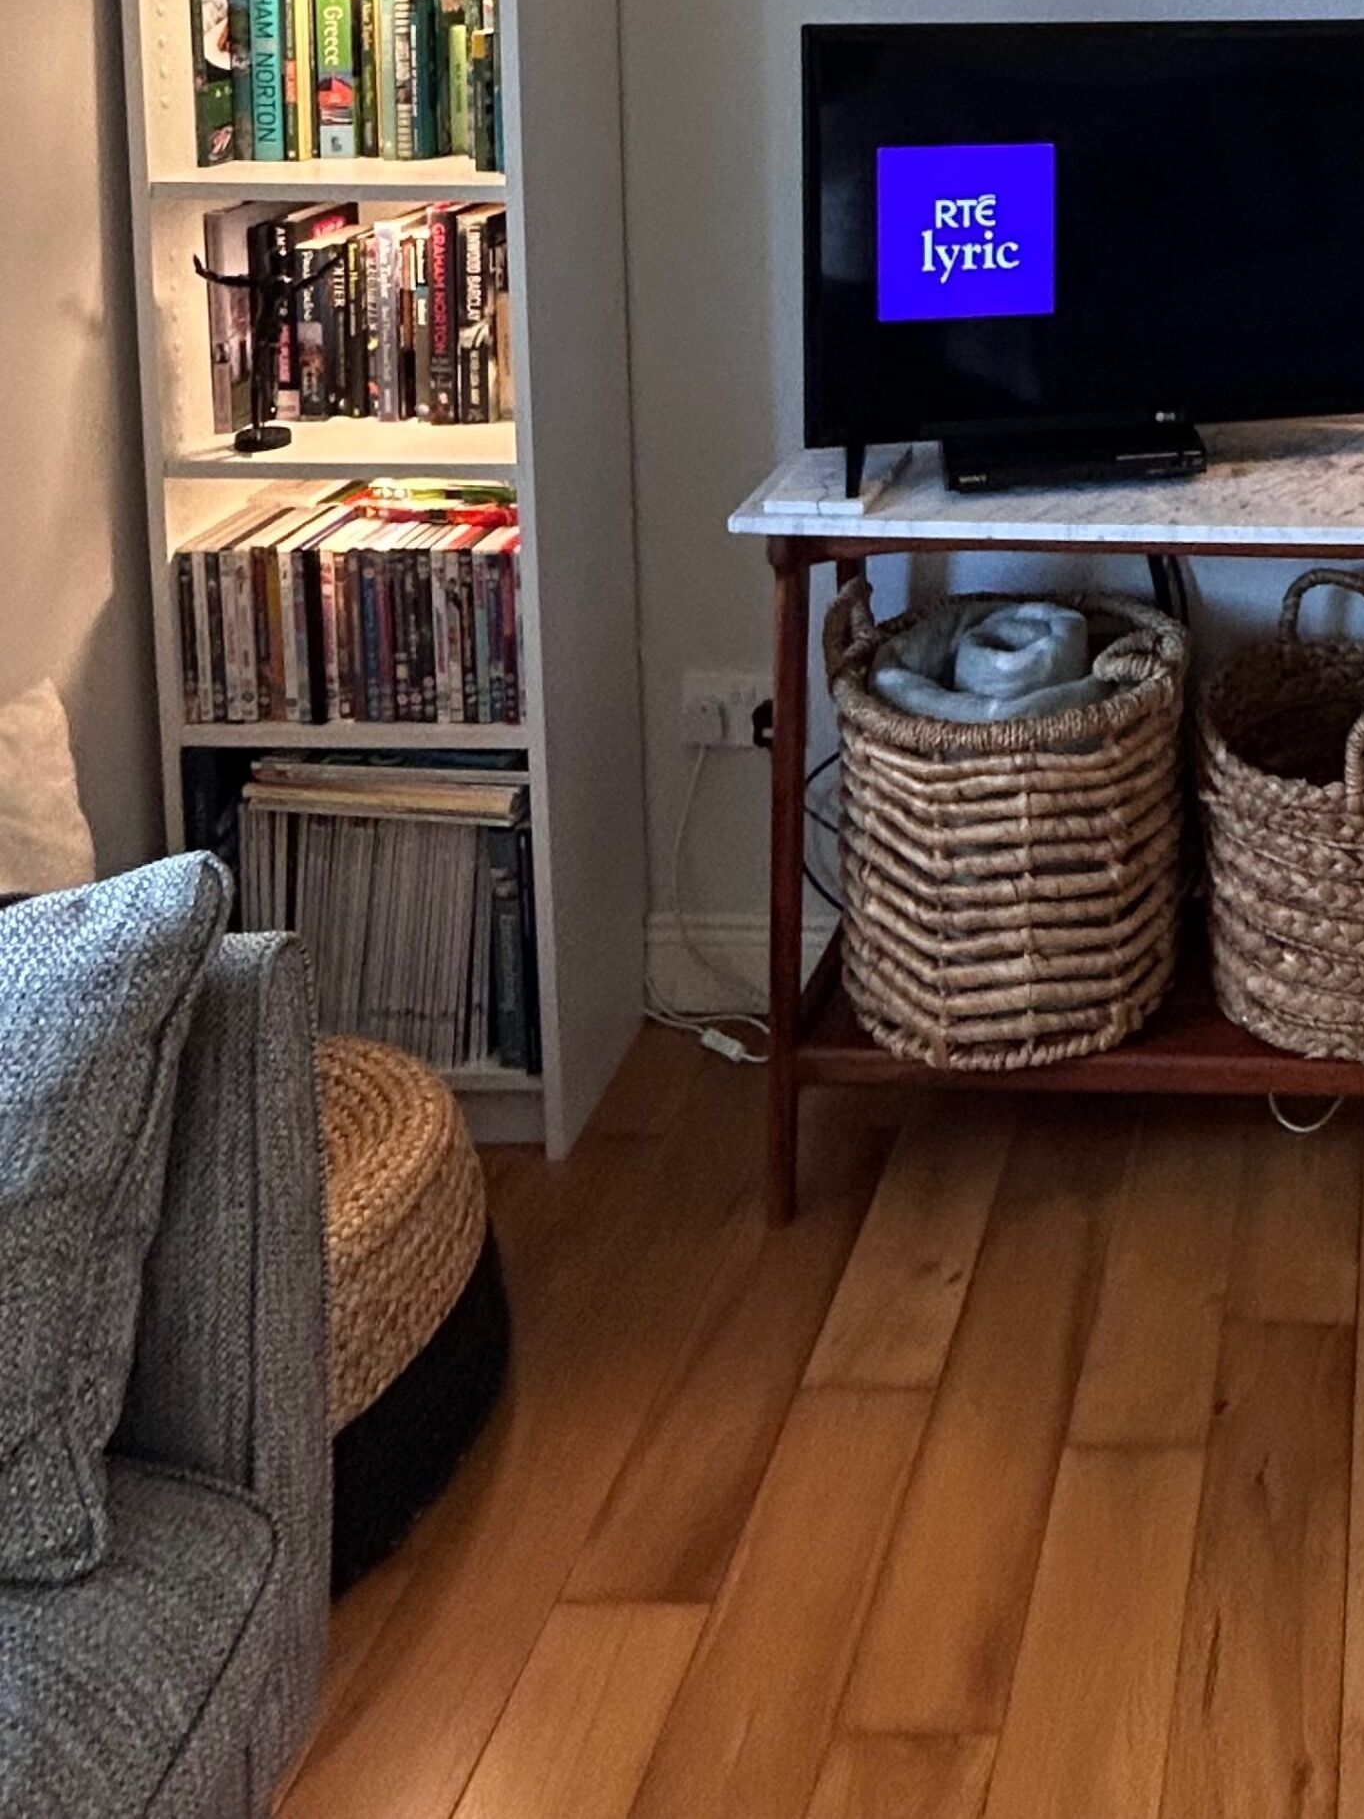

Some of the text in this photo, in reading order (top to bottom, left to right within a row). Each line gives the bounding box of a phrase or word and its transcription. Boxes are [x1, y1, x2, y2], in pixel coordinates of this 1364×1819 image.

[323, 6, 344, 66] Greece
[255, 52, 277, 142] NORTON
[935, 194, 997, 229] RTÉ
[921, 229, 1020, 284] lyric
[432, 222, 447, 355] GRAHAM NORTON
[466, 275, 482, 322] BARCLAY
